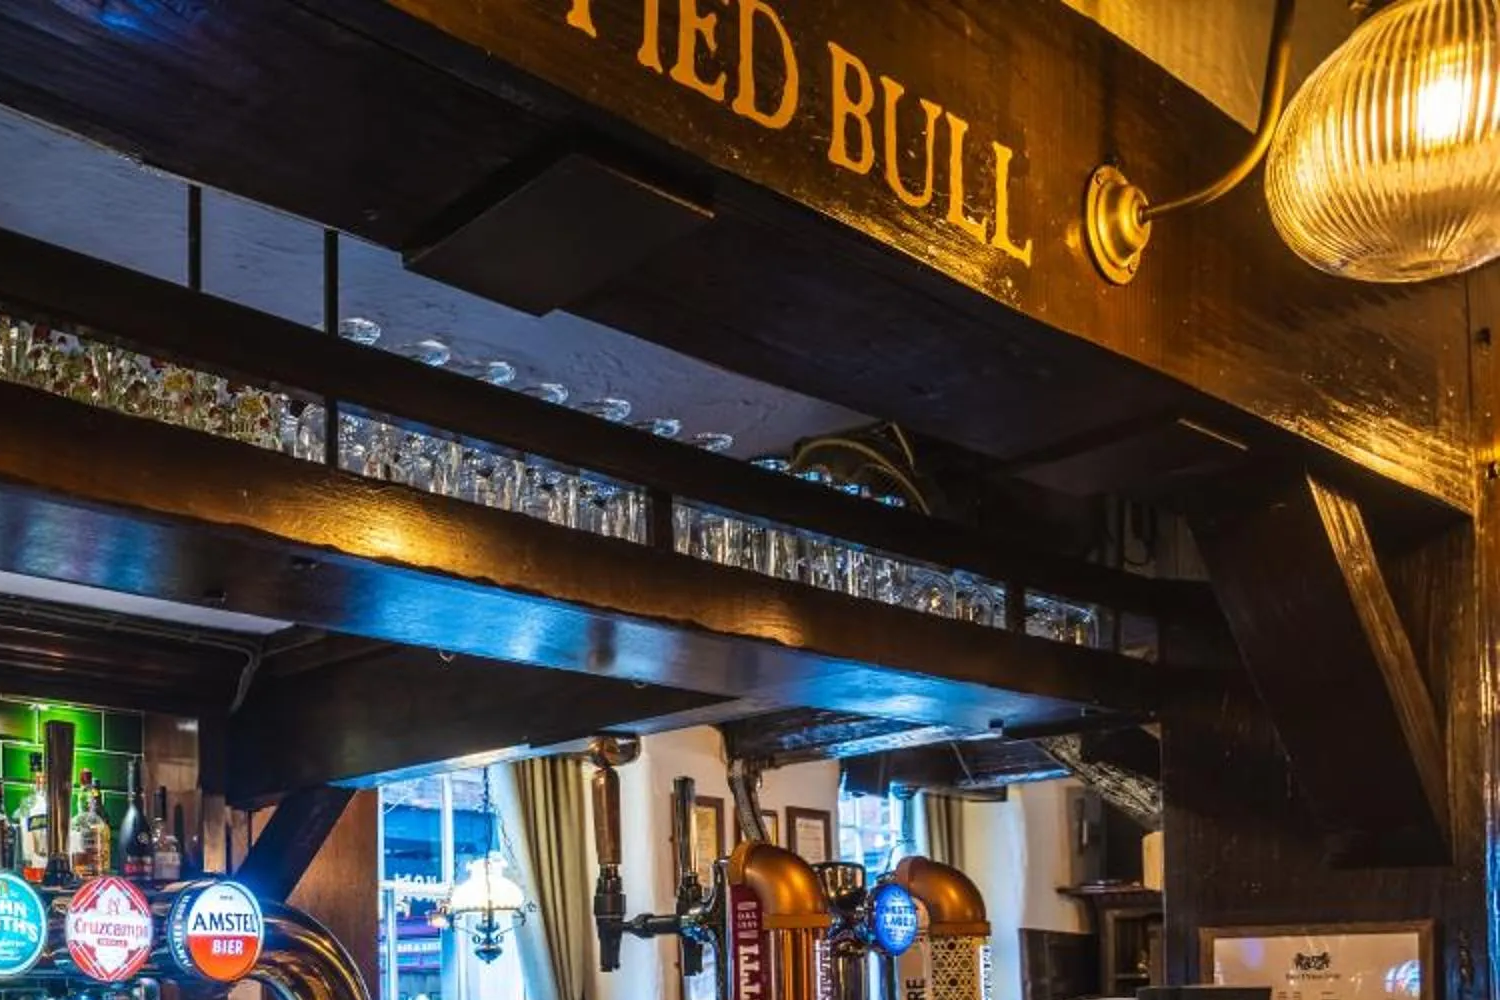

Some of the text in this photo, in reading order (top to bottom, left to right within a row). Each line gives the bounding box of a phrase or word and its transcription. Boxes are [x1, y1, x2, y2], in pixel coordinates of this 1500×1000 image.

[566, 0, 1033, 268] IED BULL
[191, 911, 259, 933] AMSTEL
[211, 938, 245, 955] BIER
